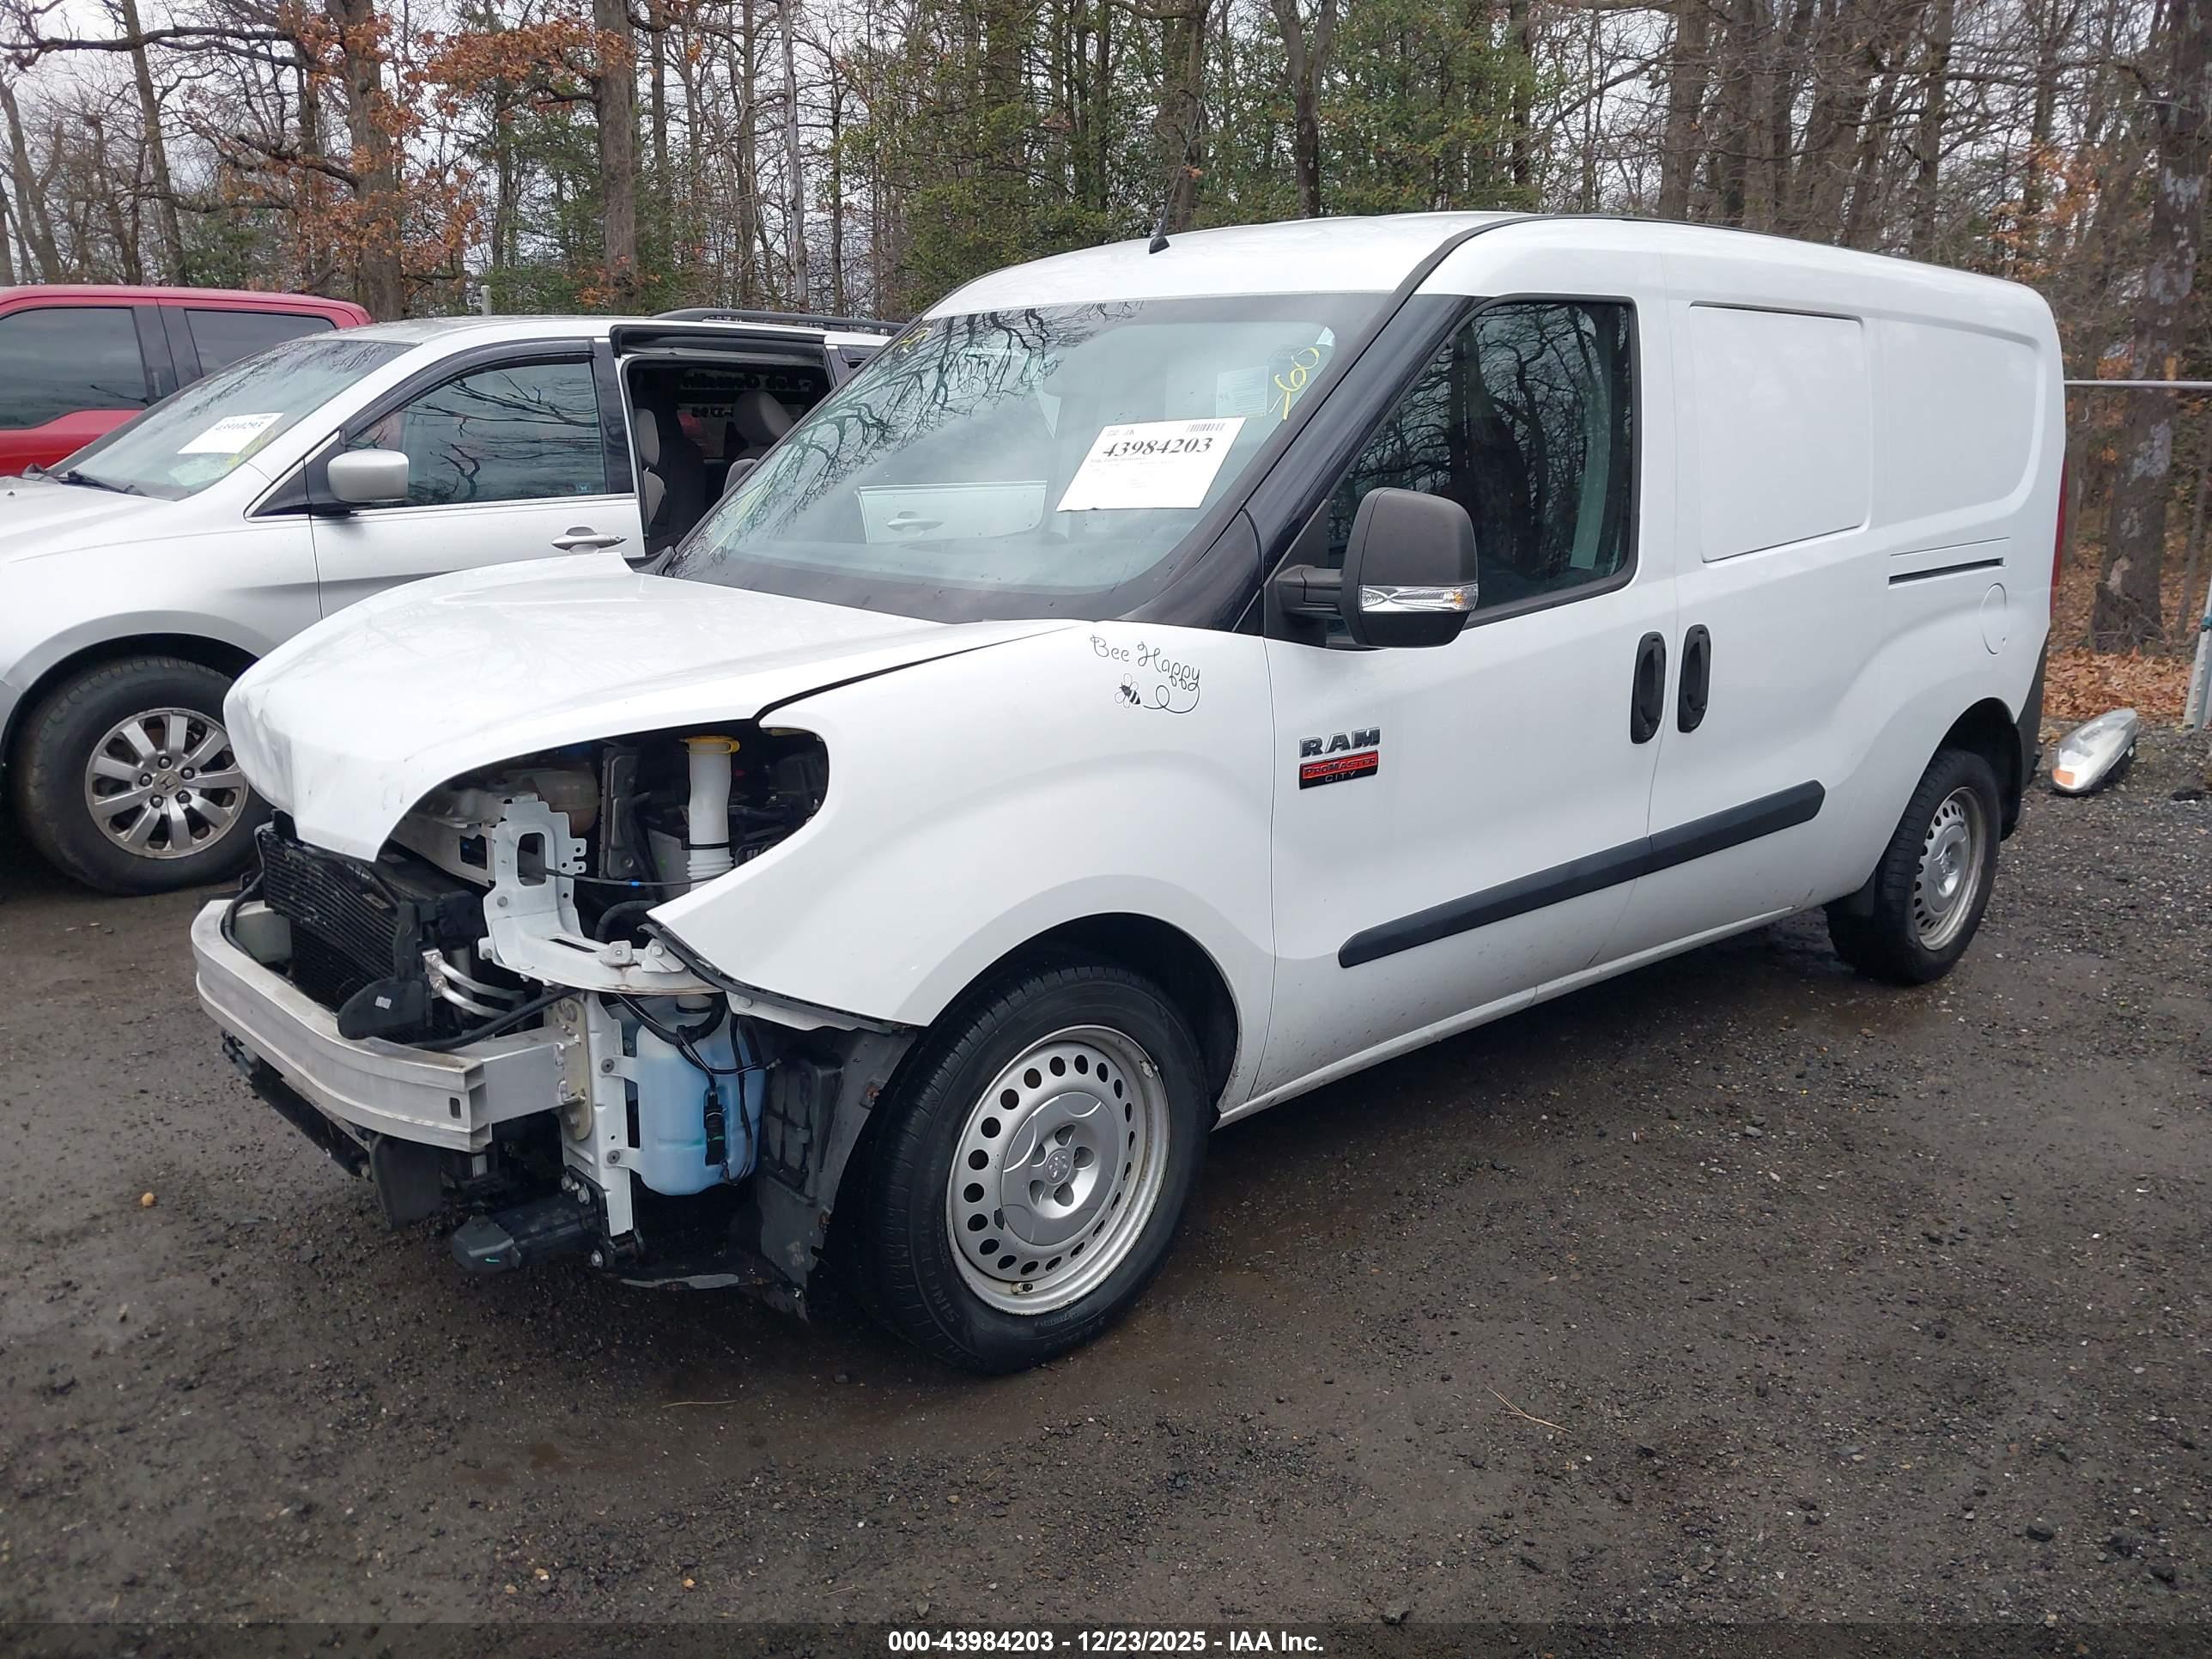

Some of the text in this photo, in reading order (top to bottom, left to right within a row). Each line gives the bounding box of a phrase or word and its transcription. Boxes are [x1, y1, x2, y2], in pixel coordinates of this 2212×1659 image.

[1103, 437, 1213, 457] 43984203
[1090, 634, 1200, 691] Bee Happy
[1298, 726, 1381, 758] RAM
[1325, 769, 1357, 782] CITY
